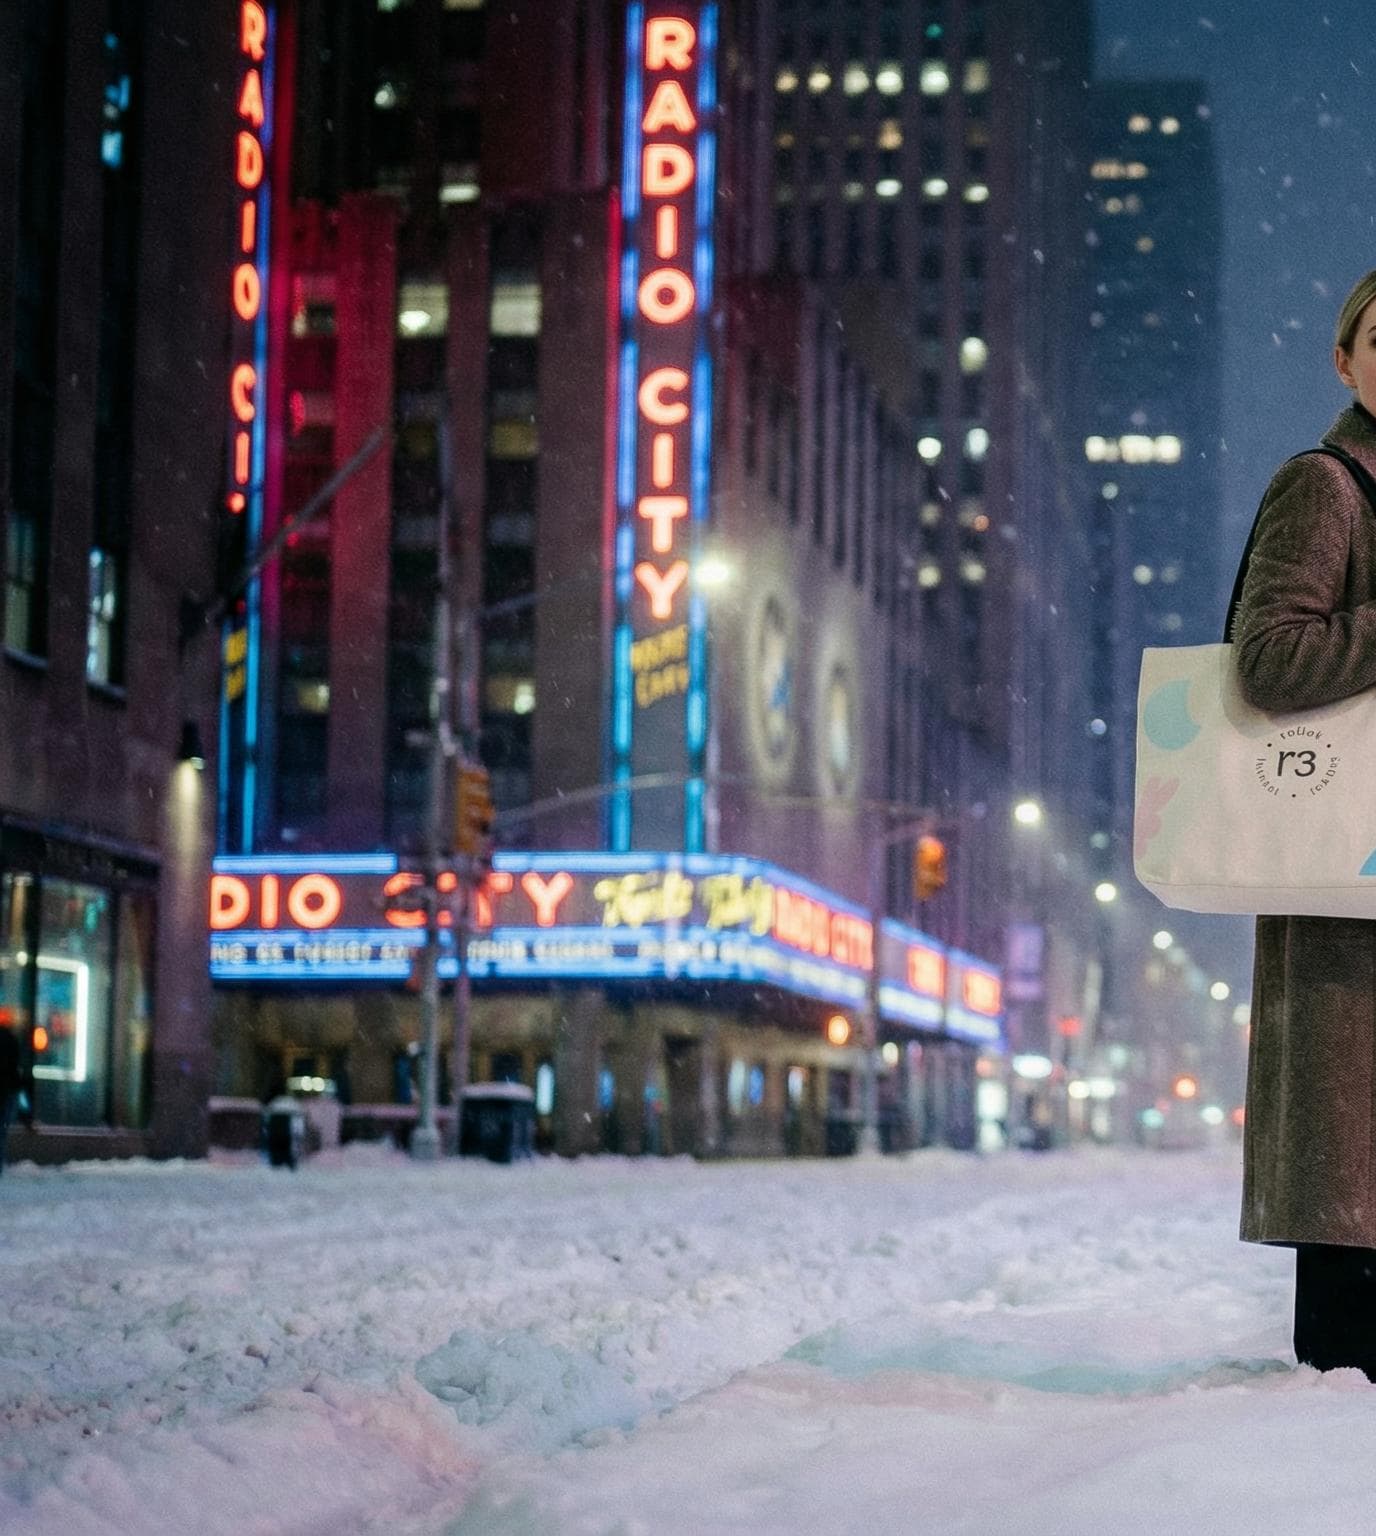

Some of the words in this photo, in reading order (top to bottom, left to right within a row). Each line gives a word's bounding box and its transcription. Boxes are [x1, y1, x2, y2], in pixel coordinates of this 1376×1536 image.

[231, 0, 268, 322] RADIO
[638, 17, 696, 324] RADIO
[635, 368, 690, 619] CITY
[1276, 749, 1318, 778] r3
